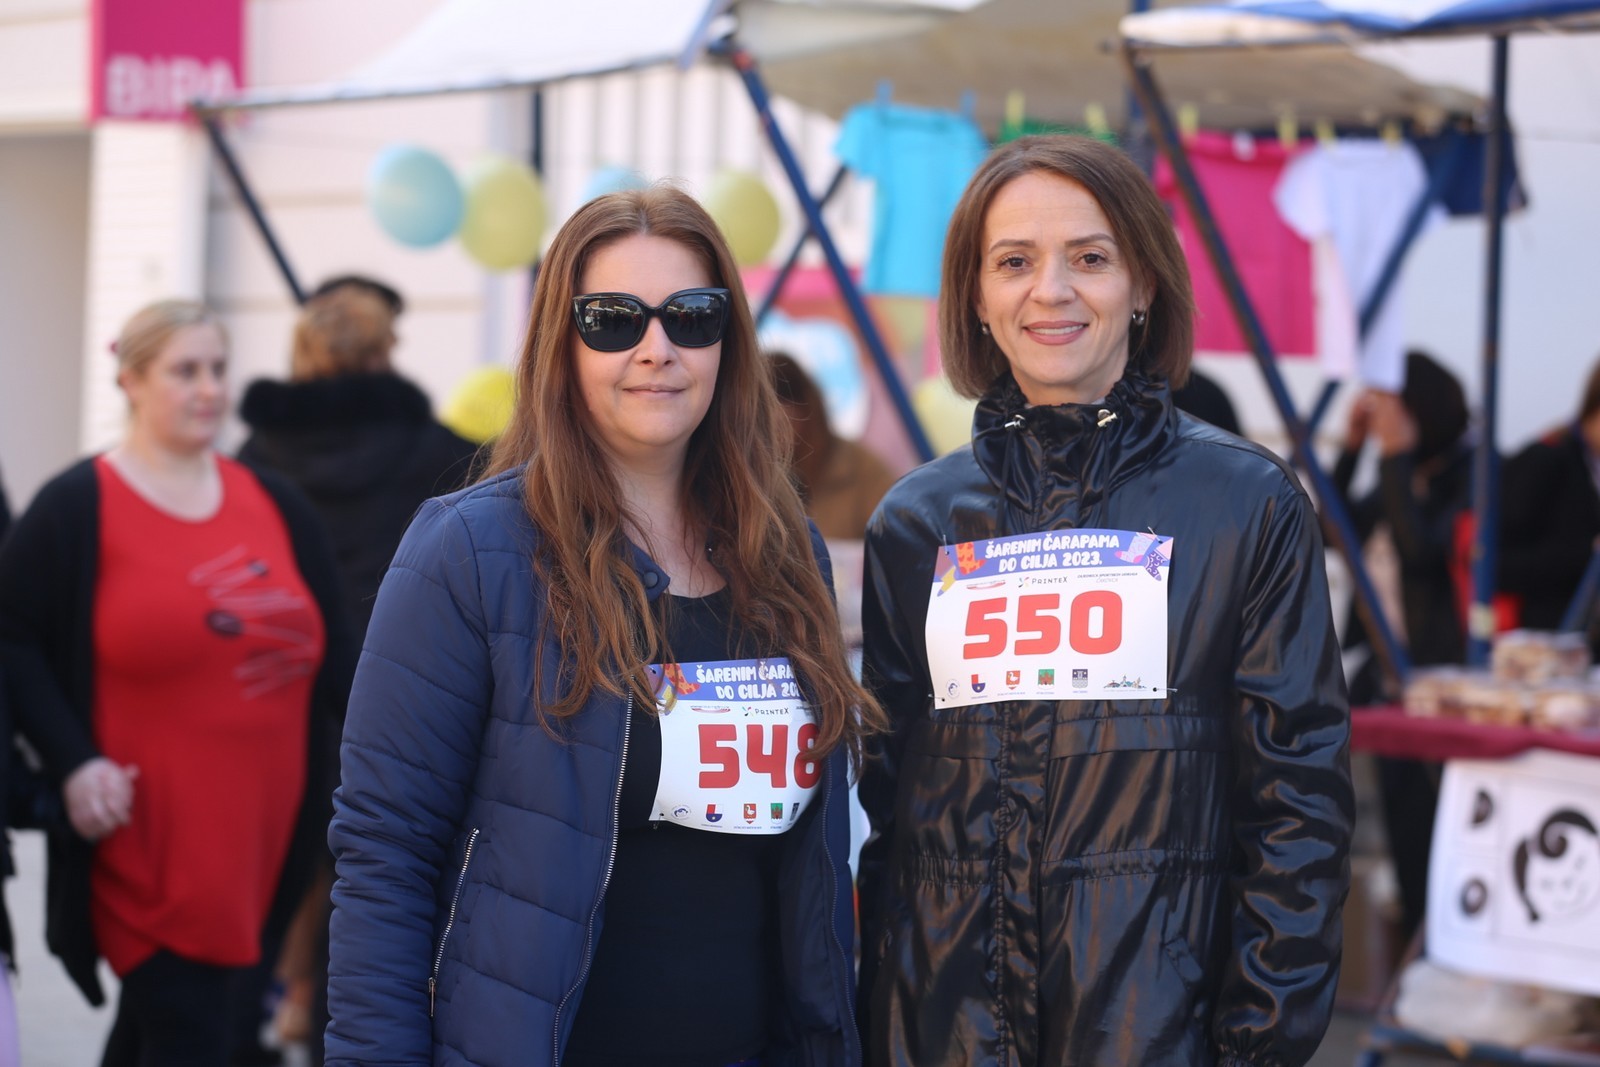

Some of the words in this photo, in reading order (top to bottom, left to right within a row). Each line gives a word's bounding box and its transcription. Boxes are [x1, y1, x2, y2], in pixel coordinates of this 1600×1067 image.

[985, 541, 1041, 559] ŠARENIM
[1043, 533, 1119, 551] ČARAPAMA
[998, 557, 1017, 572] DO
[1021, 554, 1058, 569] CILJA
[1062, 551, 1102, 566] 2023.
[963, 590, 1123, 660] 550
[696, 665, 757, 683] ŠARENIM
[715, 685, 734, 699] DO
[738, 683, 777, 699] CILJA
[698, 723, 821, 788] 548
